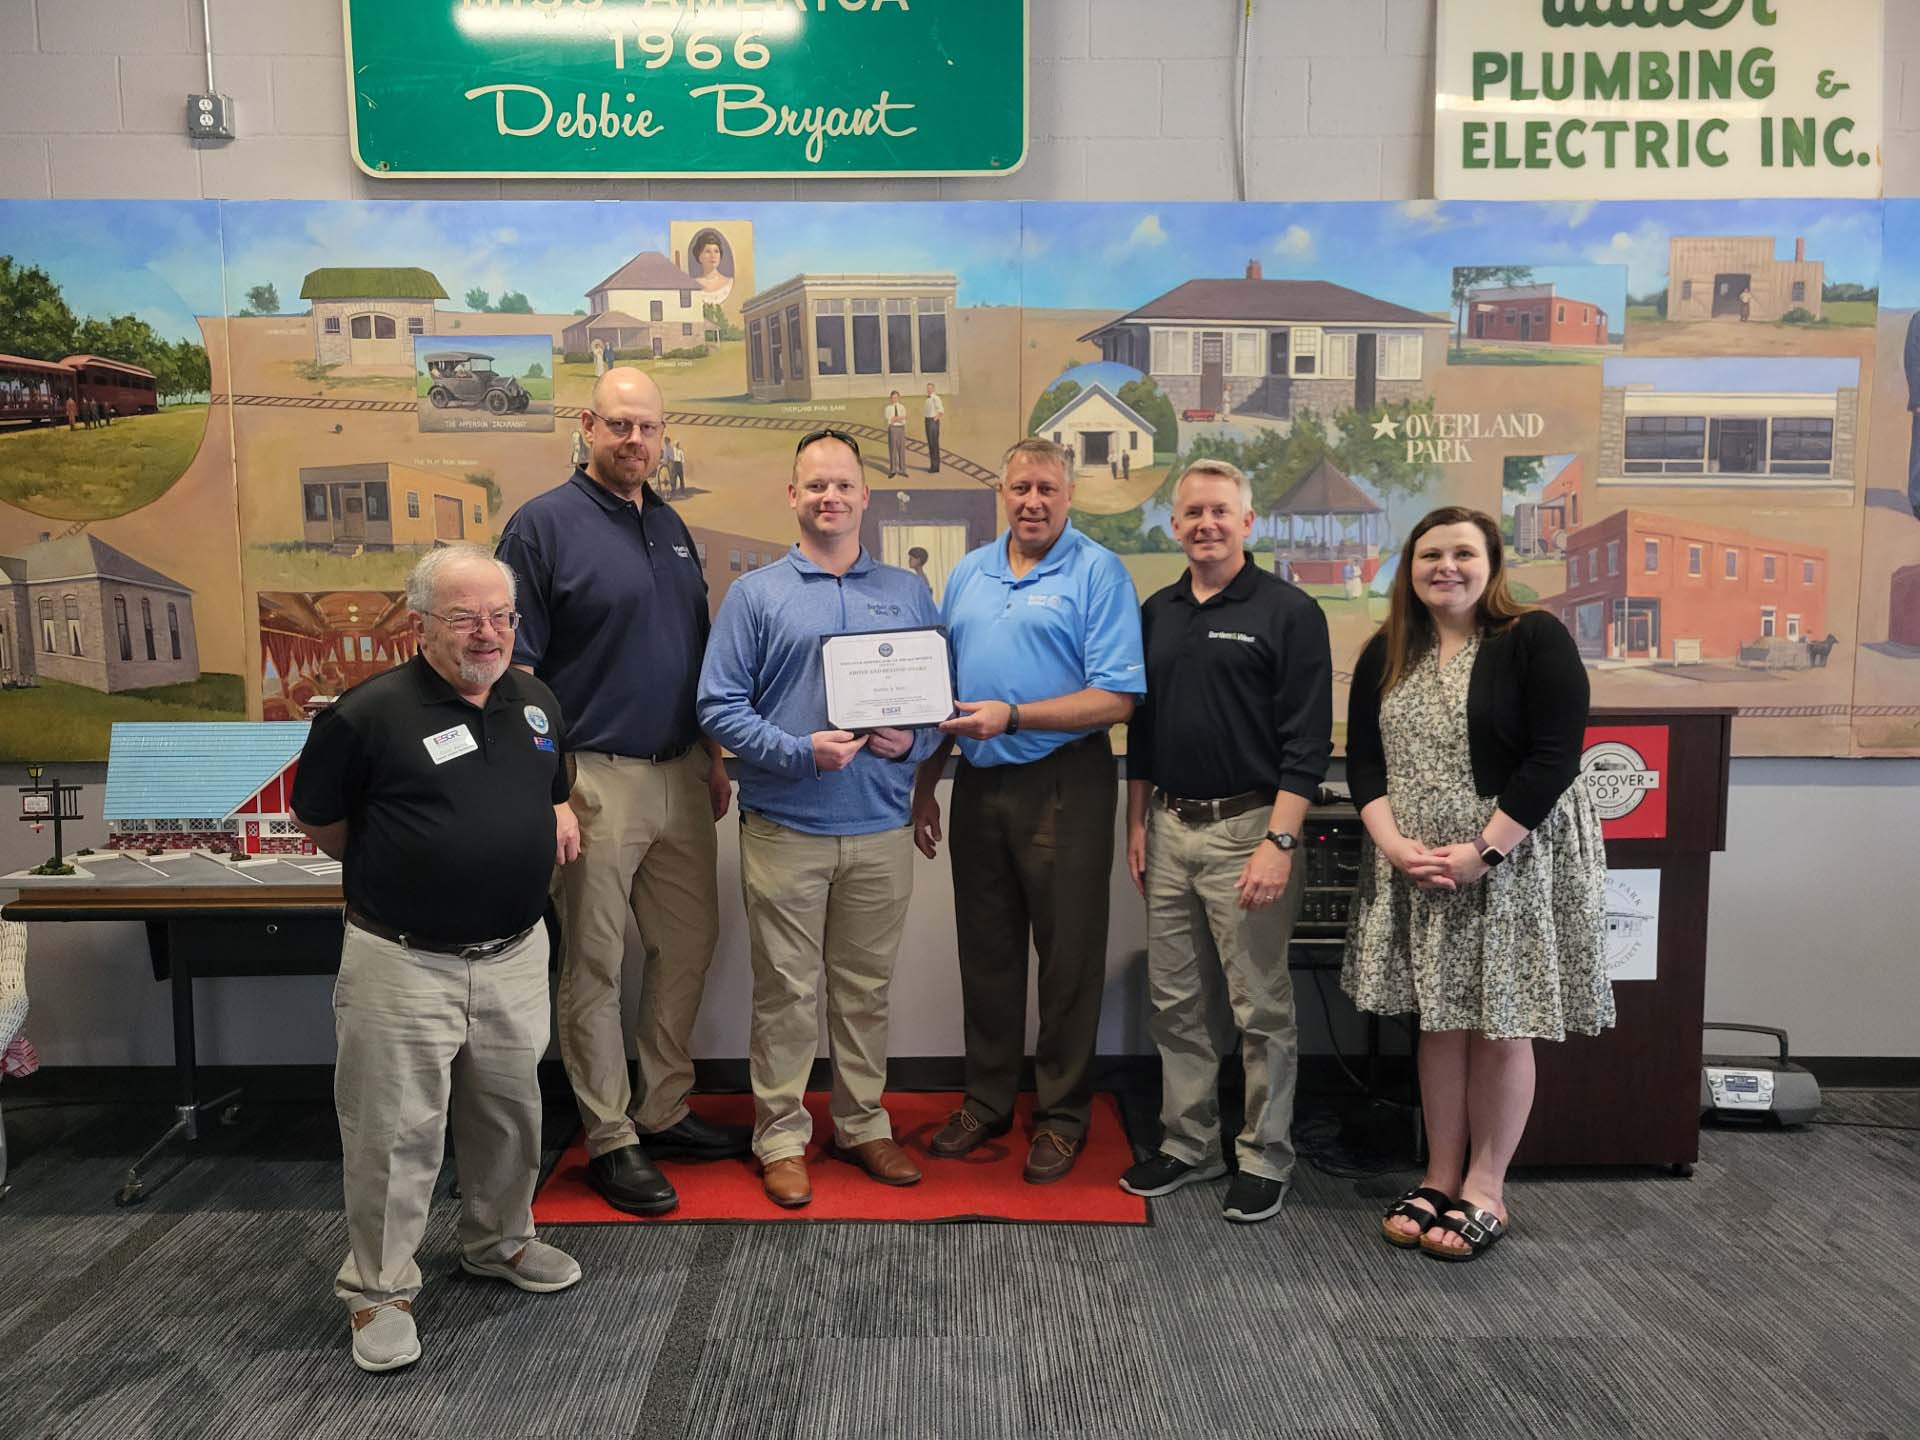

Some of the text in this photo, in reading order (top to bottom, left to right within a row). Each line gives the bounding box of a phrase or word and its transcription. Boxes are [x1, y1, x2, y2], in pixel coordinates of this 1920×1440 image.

[609, 31, 771, 70] 1966
[1472, 48, 1850, 101] PLUMBING &
[465, 83, 917, 162] Debbie Bryant
[1462, 117, 1870, 169] ELECTRIC INC.
[1406, 413, 1545, 439] OVERLAND
[1406, 439, 1473, 464] PARK
